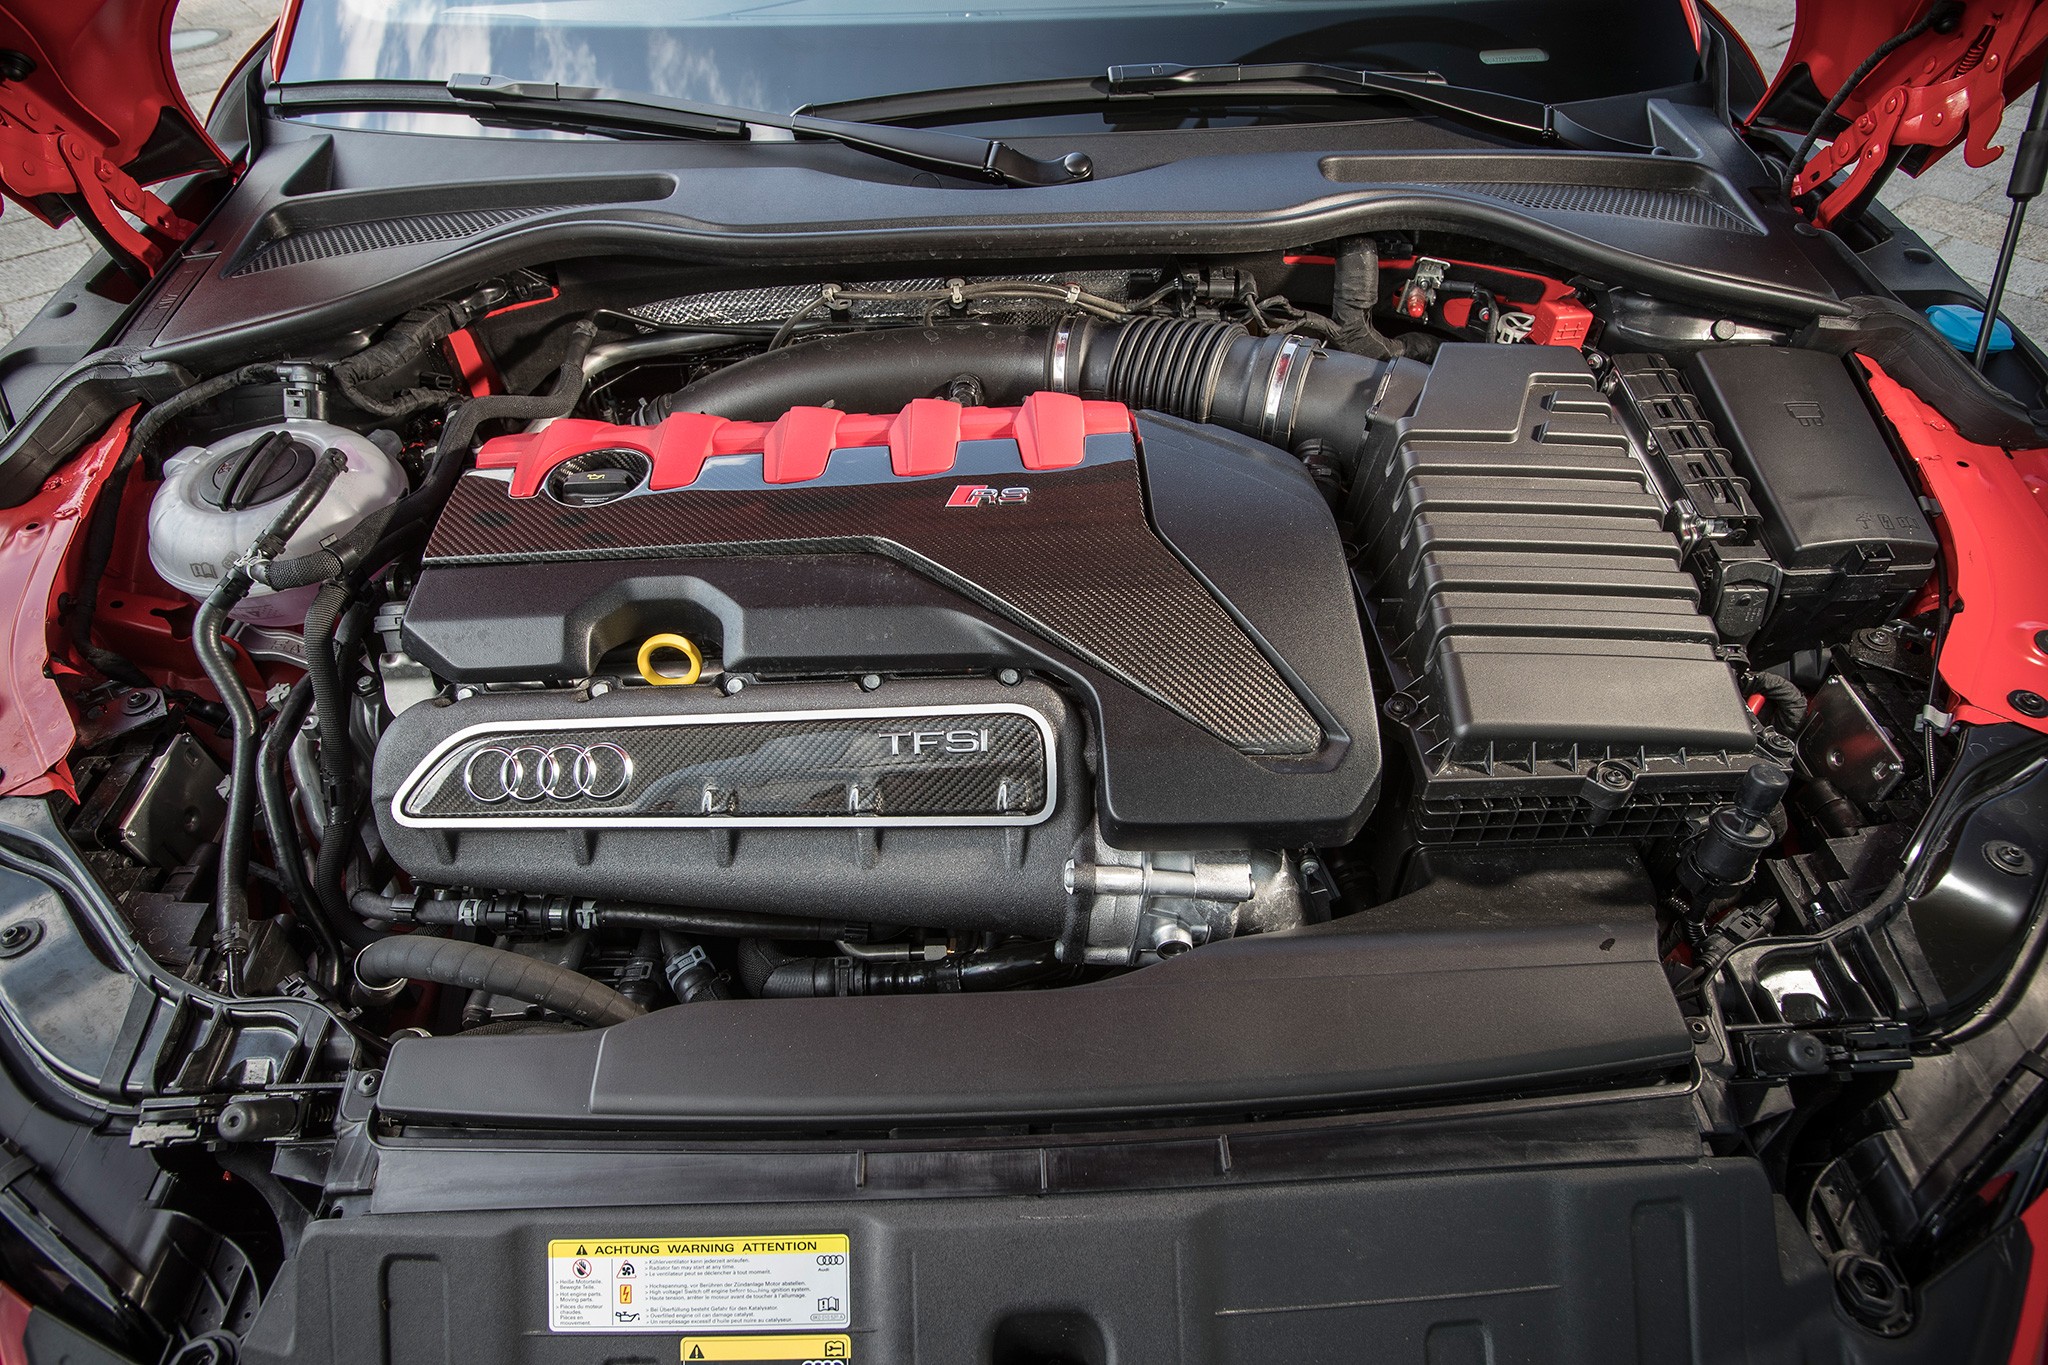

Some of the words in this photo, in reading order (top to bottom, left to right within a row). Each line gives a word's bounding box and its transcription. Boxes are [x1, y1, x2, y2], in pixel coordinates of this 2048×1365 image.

[962, 486, 1032, 506] RS
[878, 728, 988, 756] TFSI
[468, 976, 480, 984] 20
[594, 1246, 660, 1254] ACHTUNG
[668, 1244, 734, 1253] WARNING
[742, 1242, 817, 1252] ATTENTION
